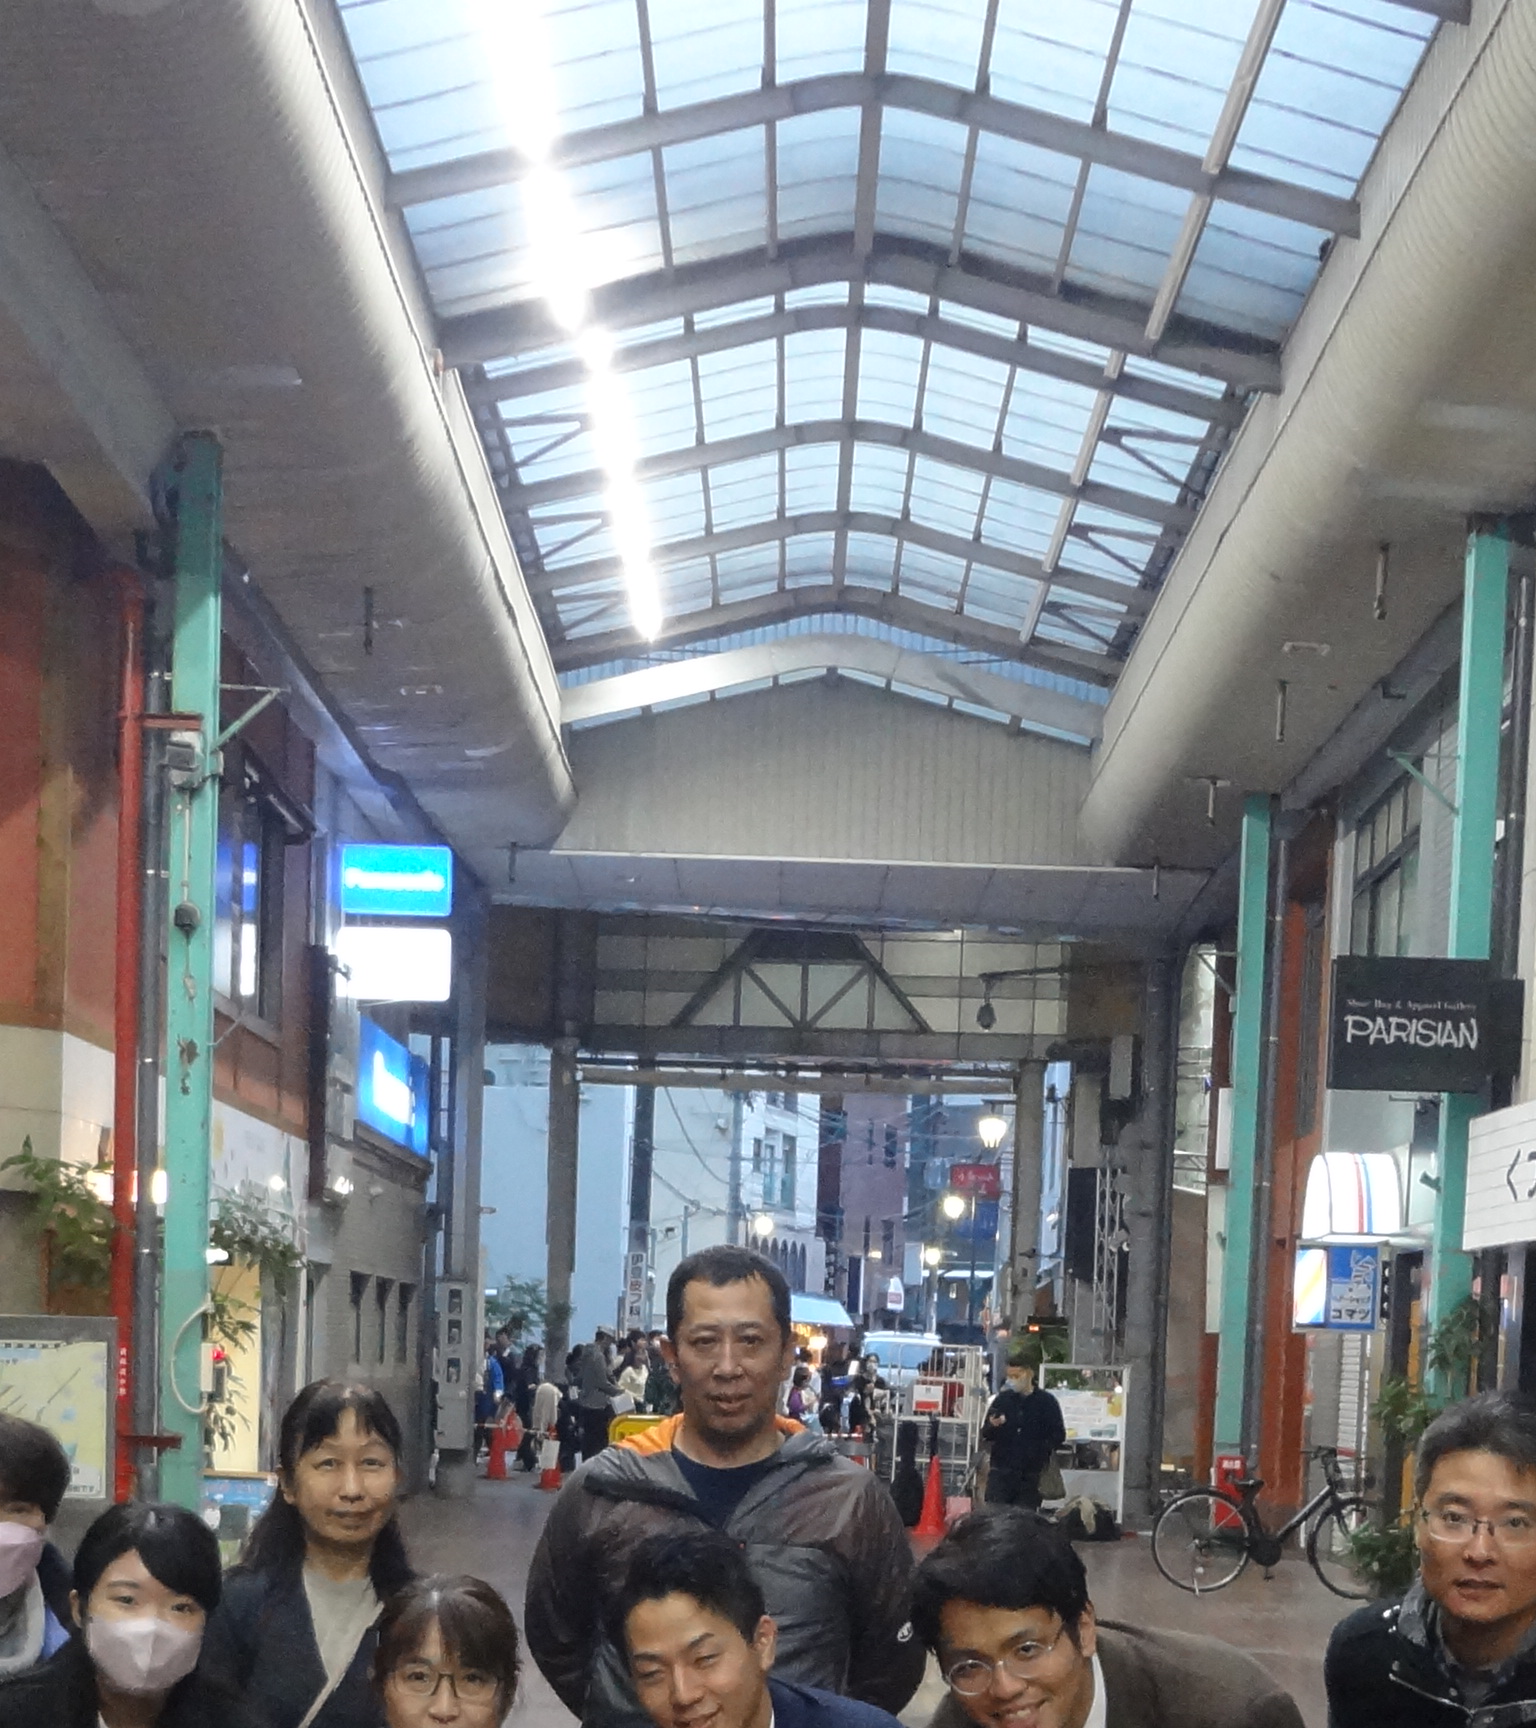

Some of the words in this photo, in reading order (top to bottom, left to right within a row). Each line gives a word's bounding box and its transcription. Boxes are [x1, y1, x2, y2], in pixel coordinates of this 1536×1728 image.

[1343, 1014, 1479, 1050] PARISIAN
[1331, 1308, 1371, 1321] コマツ
